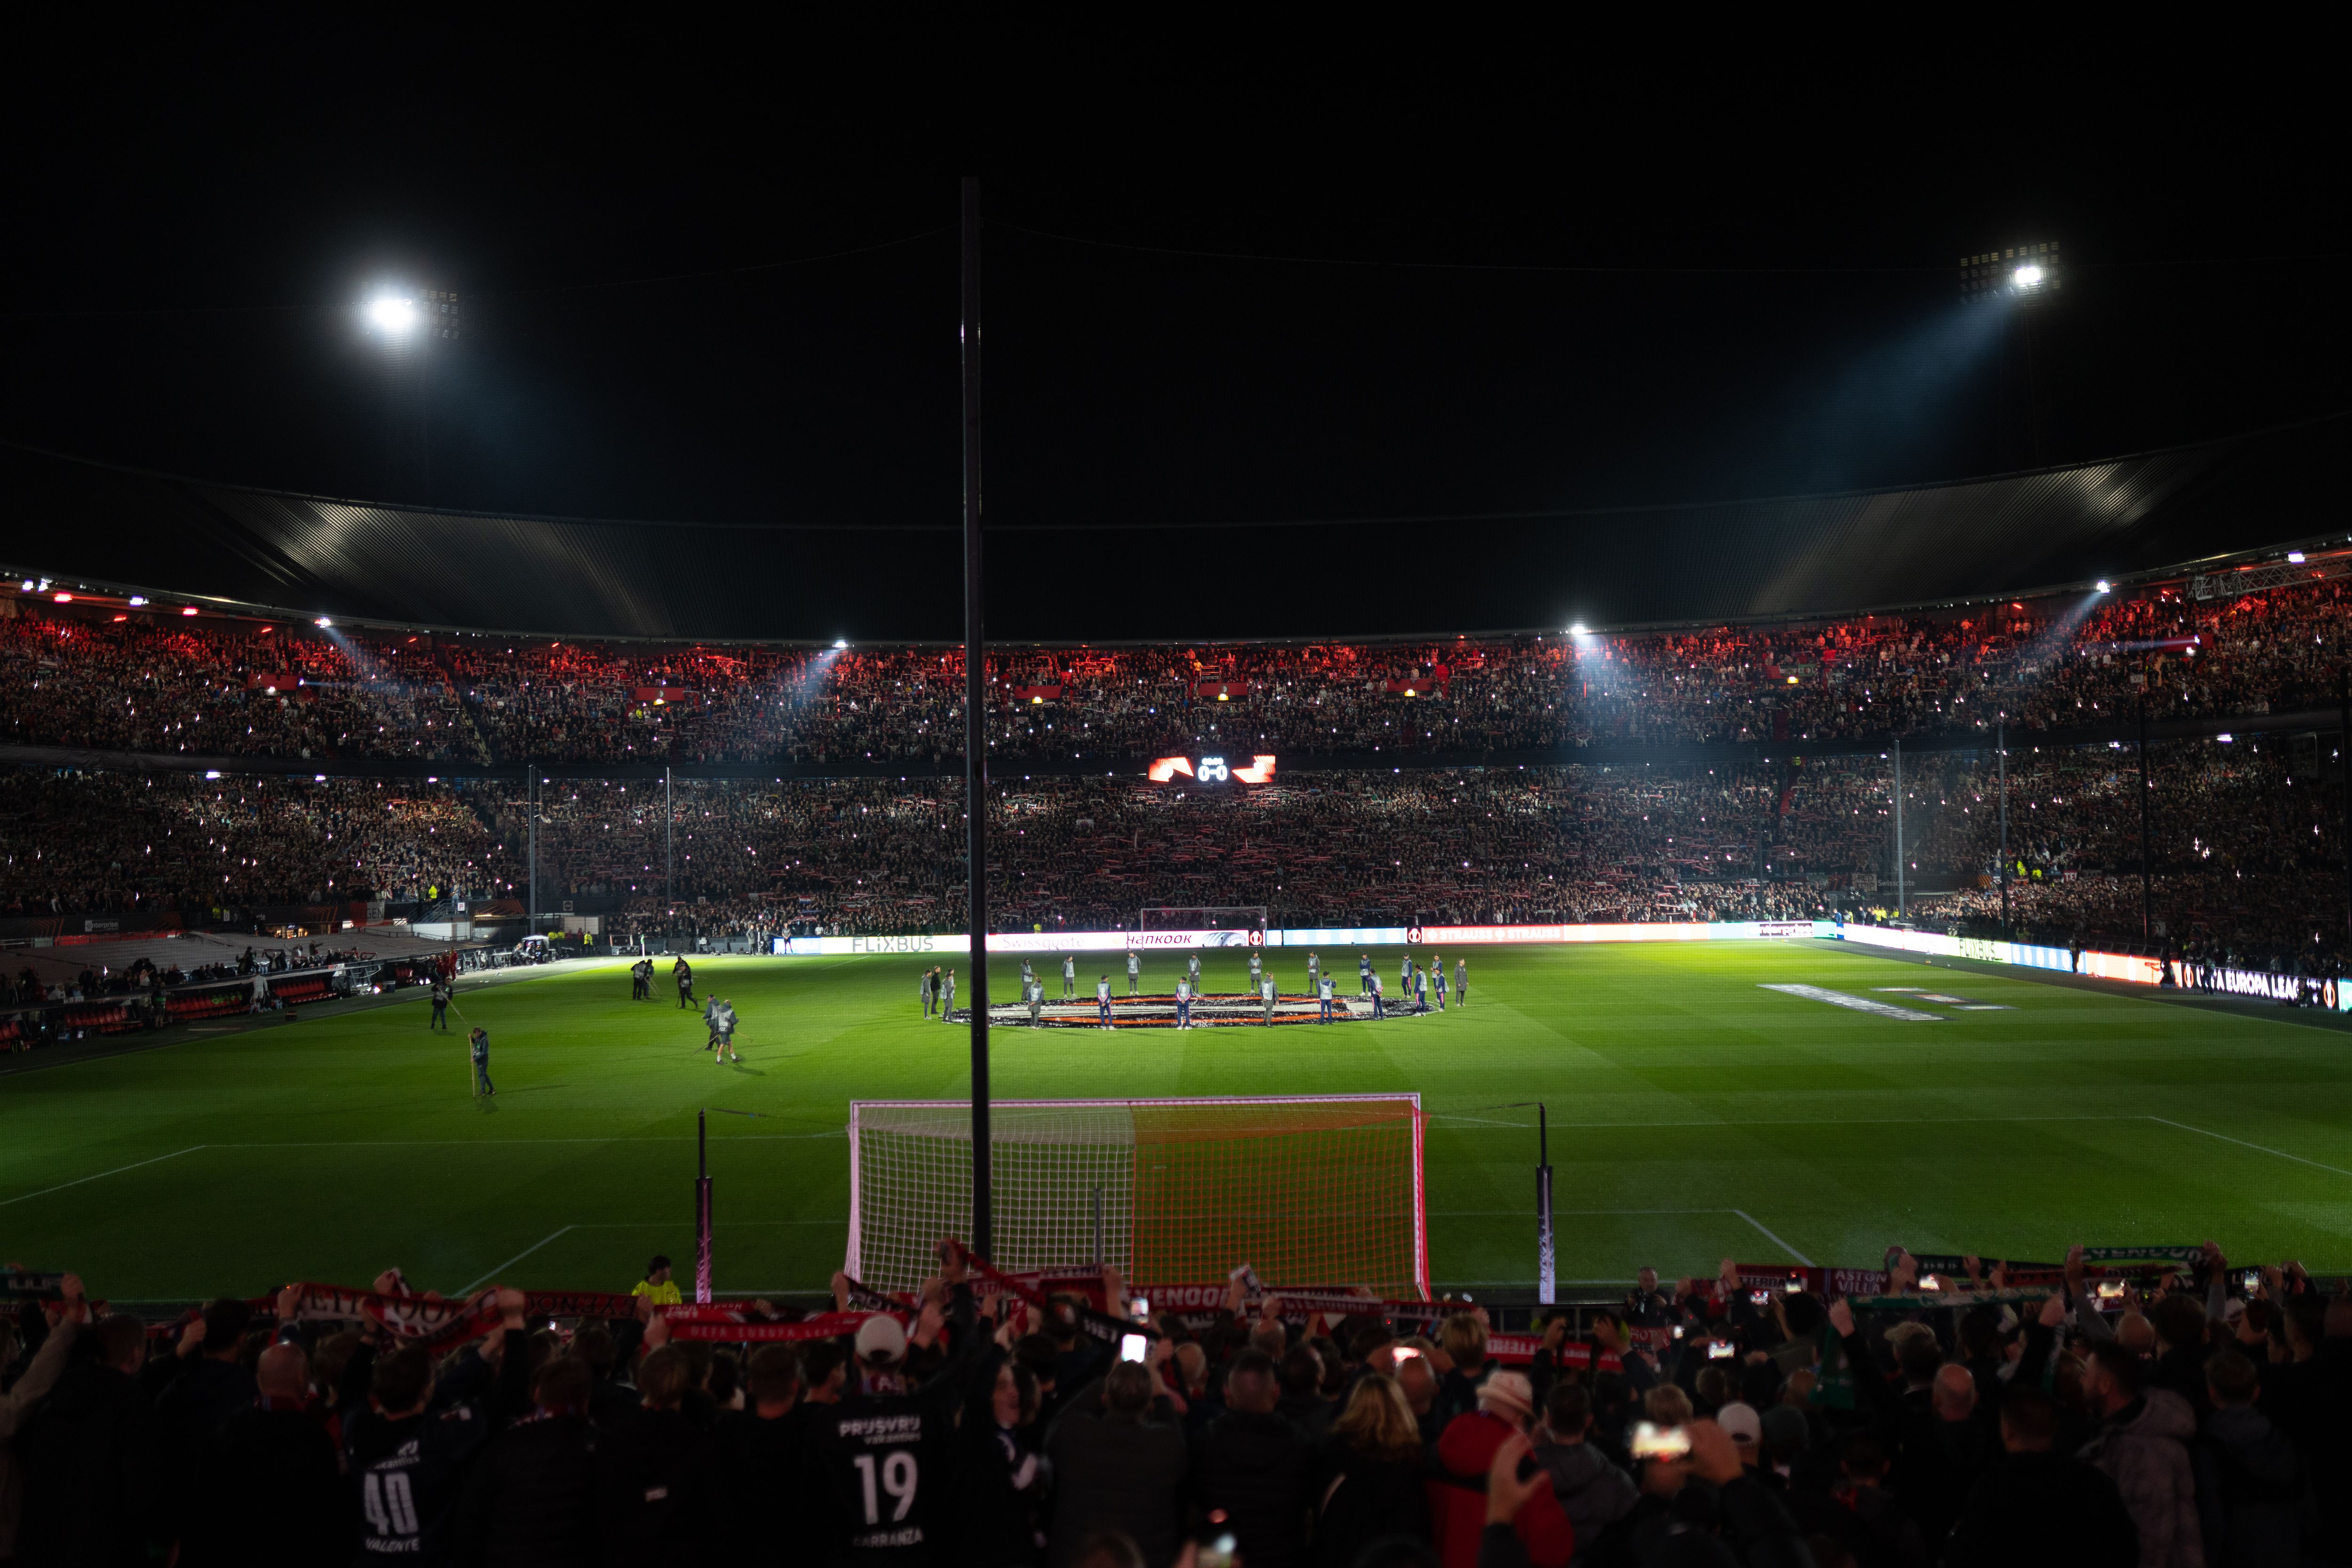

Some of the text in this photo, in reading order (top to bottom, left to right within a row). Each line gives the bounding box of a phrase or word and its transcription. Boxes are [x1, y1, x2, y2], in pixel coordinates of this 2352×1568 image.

[87, 921, 119, 929] enterprise
[1440, 929, 1493, 940] STRAUSS
[1507, 928, 1561, 939] STRAUSS
[1003, 936, 1084, 950] Swissquote
[2196, 965, 2225, 992] UFA
[2225, 968, 2271, 998] EUROPA
[1835, 1270, 1888, 1284] ASTON
[1837, 1280, 1882, 1295] VILLA
[852, 1448, 919, 1525] 19
[364, 1472, 420, 1536] 40
[365, 1536, 421, 1553] VALENTE
